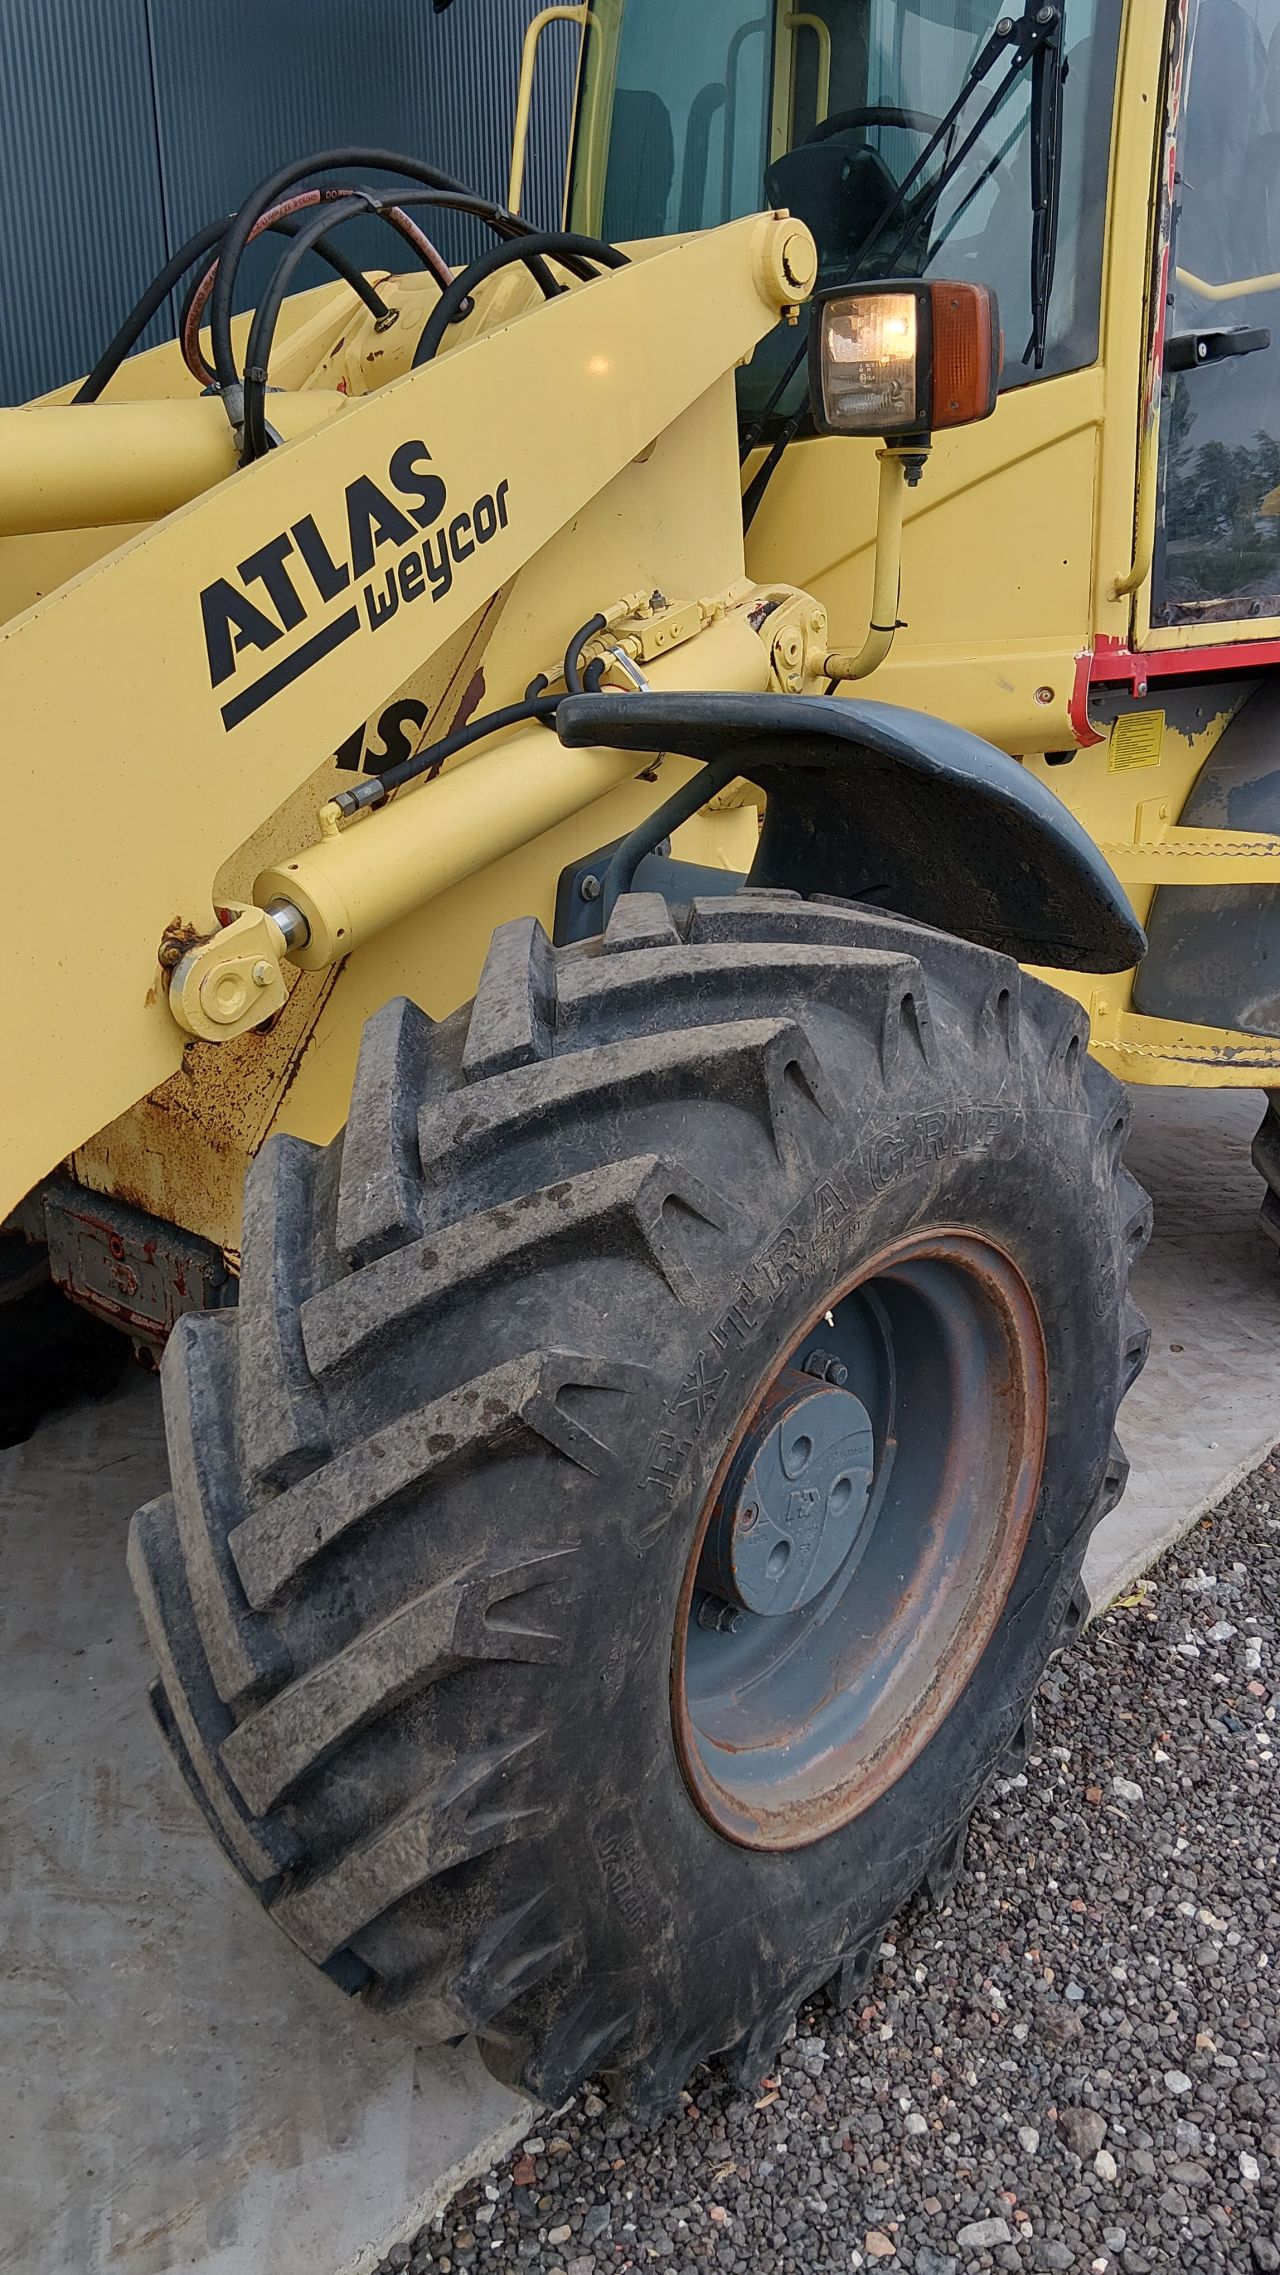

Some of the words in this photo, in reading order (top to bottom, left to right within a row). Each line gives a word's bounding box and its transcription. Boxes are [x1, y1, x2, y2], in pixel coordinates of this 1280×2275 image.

[200, 440, 446, 689] ATLAS
[363, 479, 509, 632] weycor
[638, 1179, 850, 1499] EXTRA
[869, 1102, 1005, 1191] GRIP
